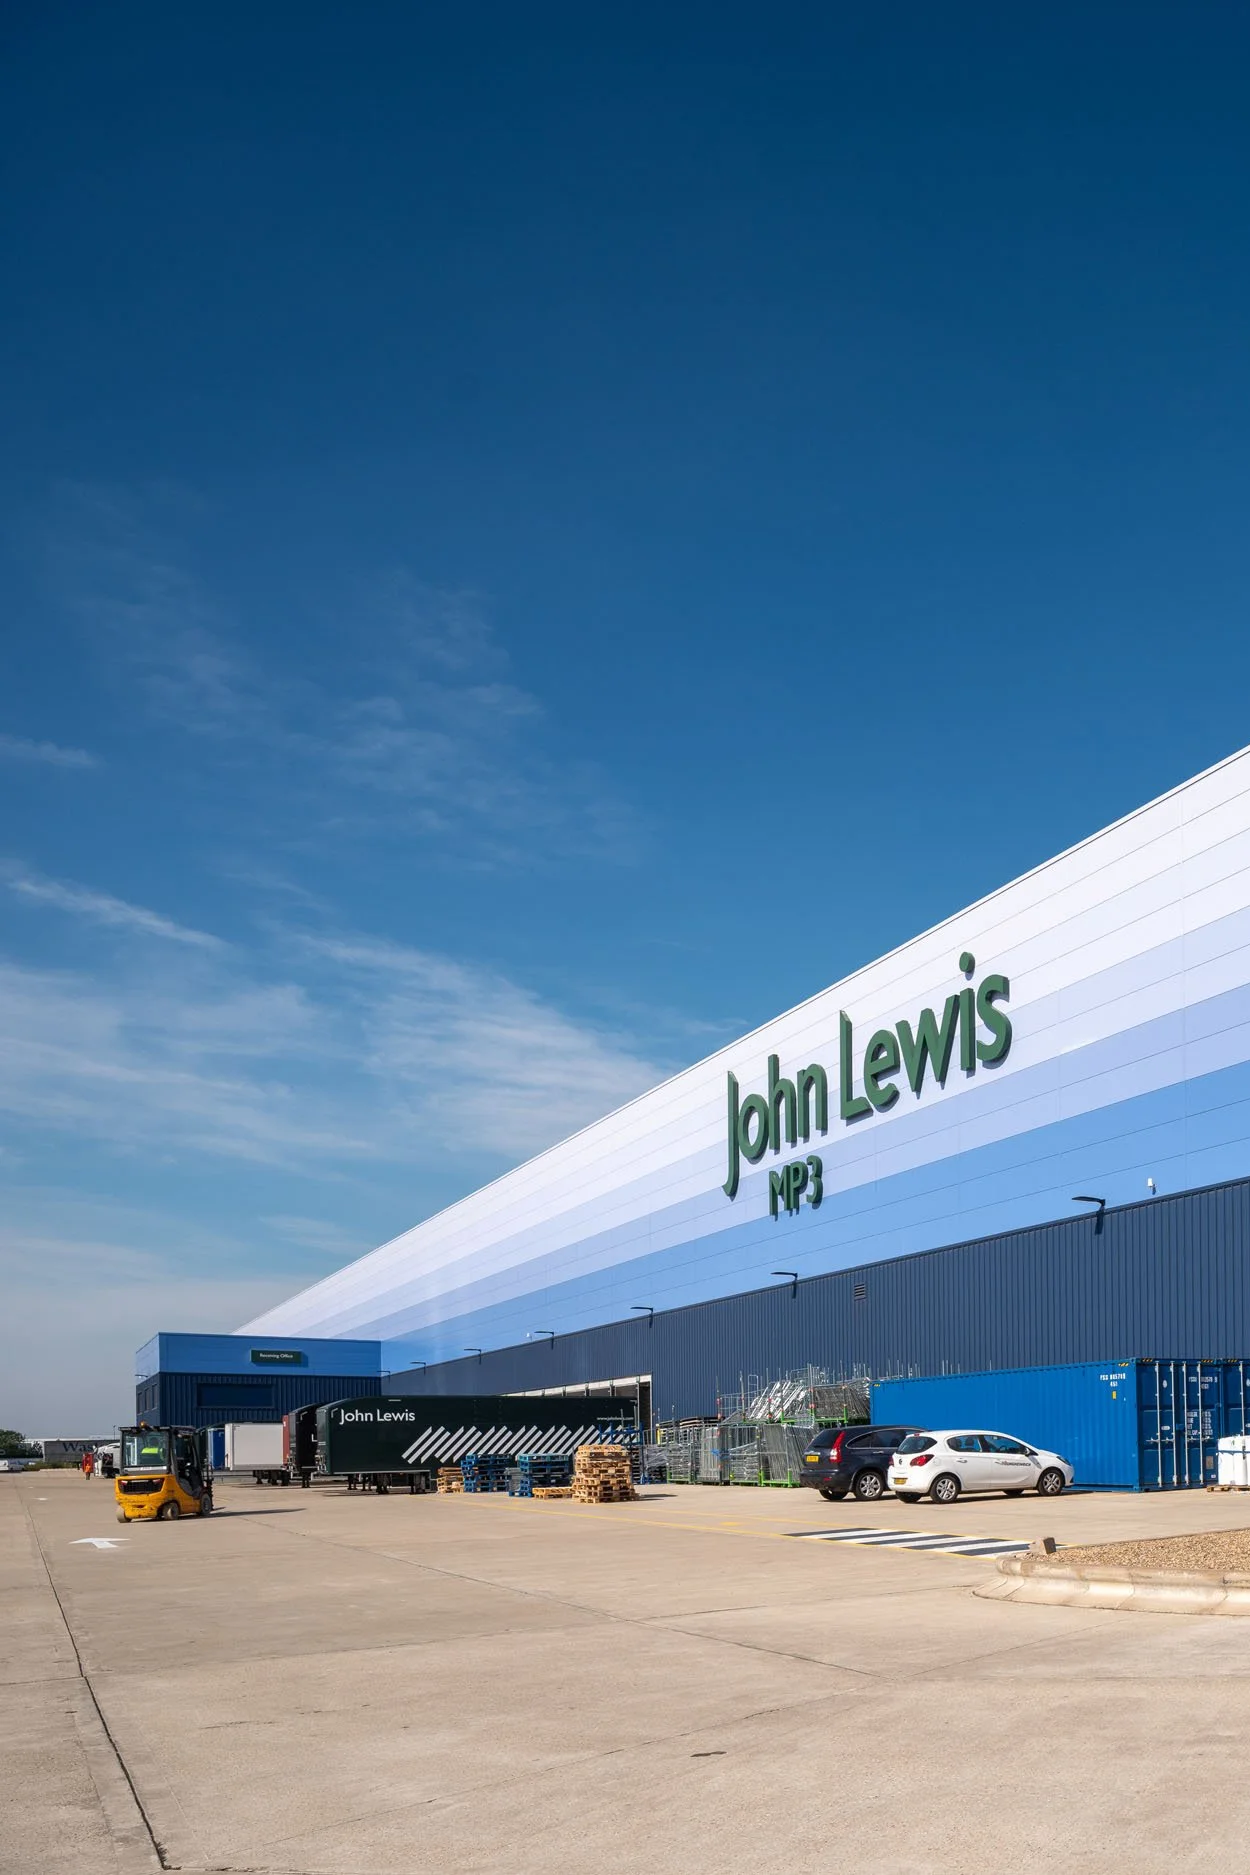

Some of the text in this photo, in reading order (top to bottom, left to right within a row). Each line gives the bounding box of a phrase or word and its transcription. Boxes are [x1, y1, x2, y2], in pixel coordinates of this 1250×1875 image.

[723, 952, 1013, 1199] John Lewis
[769, 1155, 824, 1218] MP3
[339, 1408, 416, 1426] John Lewis
[63, 1442, 93, 1452] Was
